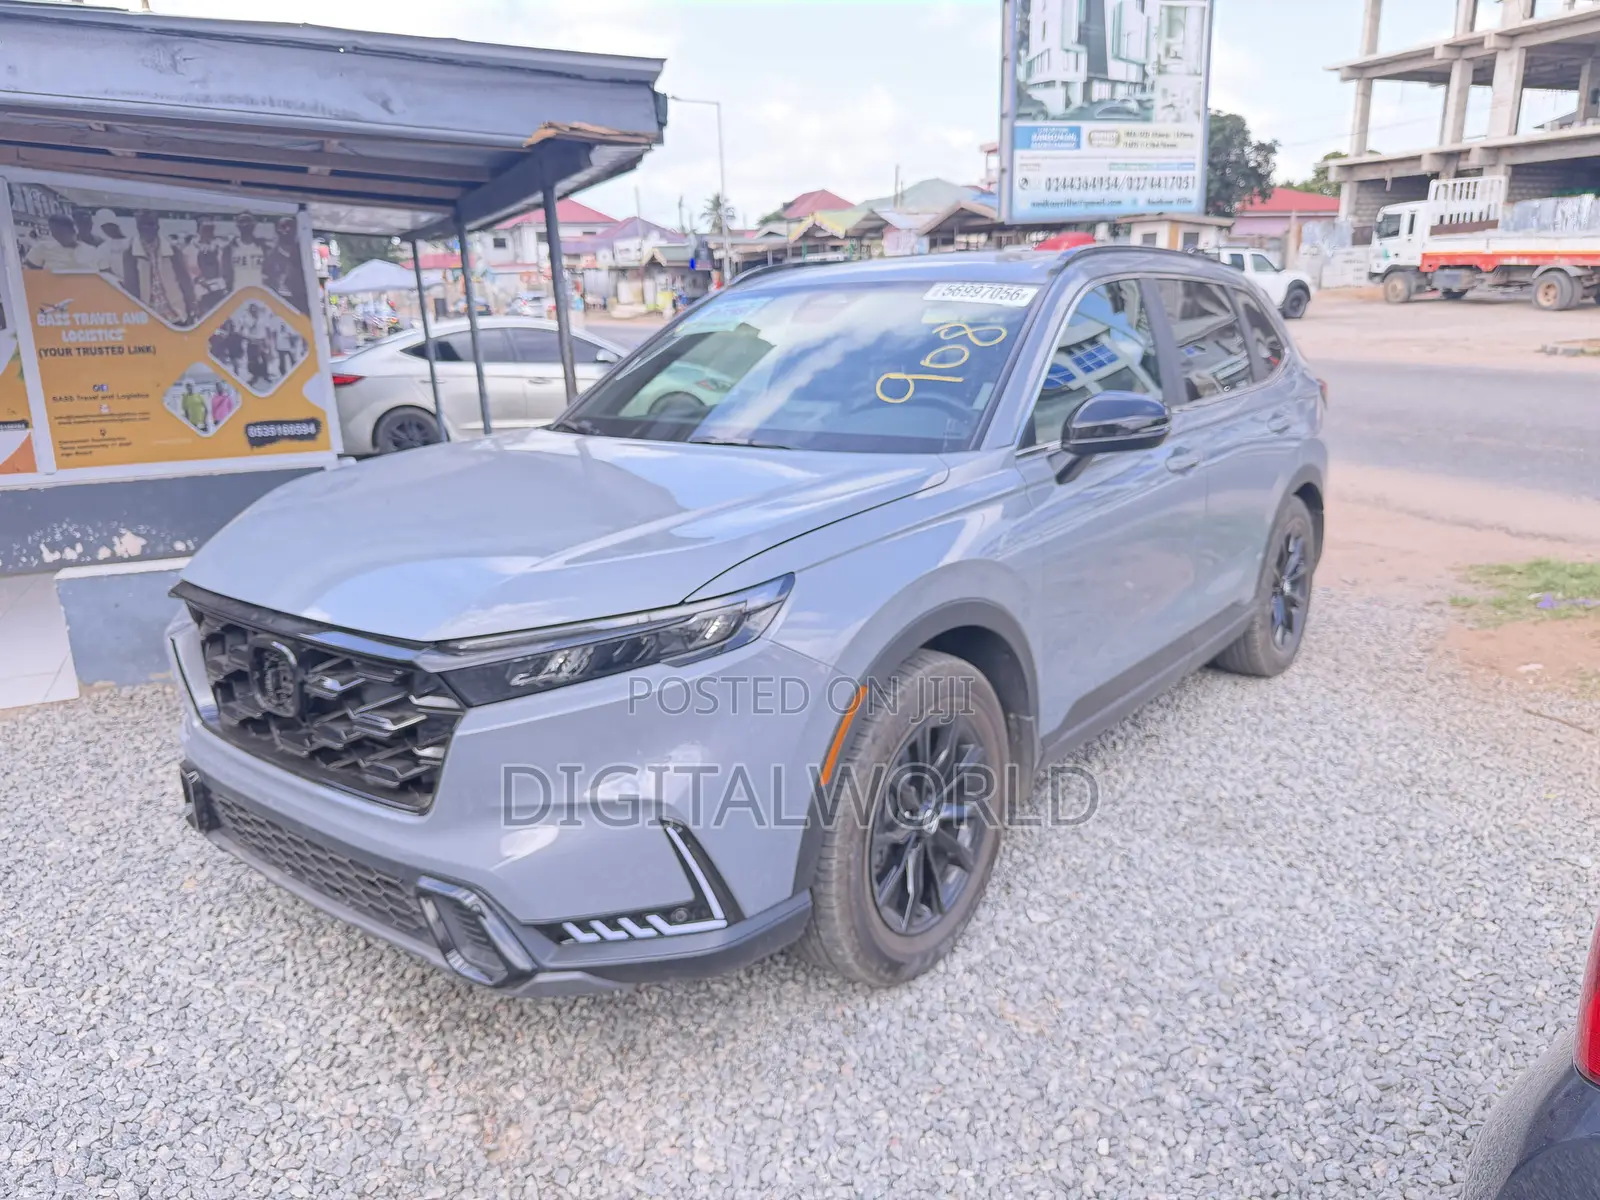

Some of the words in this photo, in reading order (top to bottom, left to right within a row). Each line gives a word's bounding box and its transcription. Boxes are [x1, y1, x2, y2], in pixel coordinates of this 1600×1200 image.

[73, 312, 119, 325] TRAVEL
[123, 311, 149, 324] AND
[62, 328, 126, 342] LOGISTICS
[39, 346, 73, 358] (YOUR
[76, 345, 124, 357] TRUSTED
[128, 344, 157, 356] LINK)
